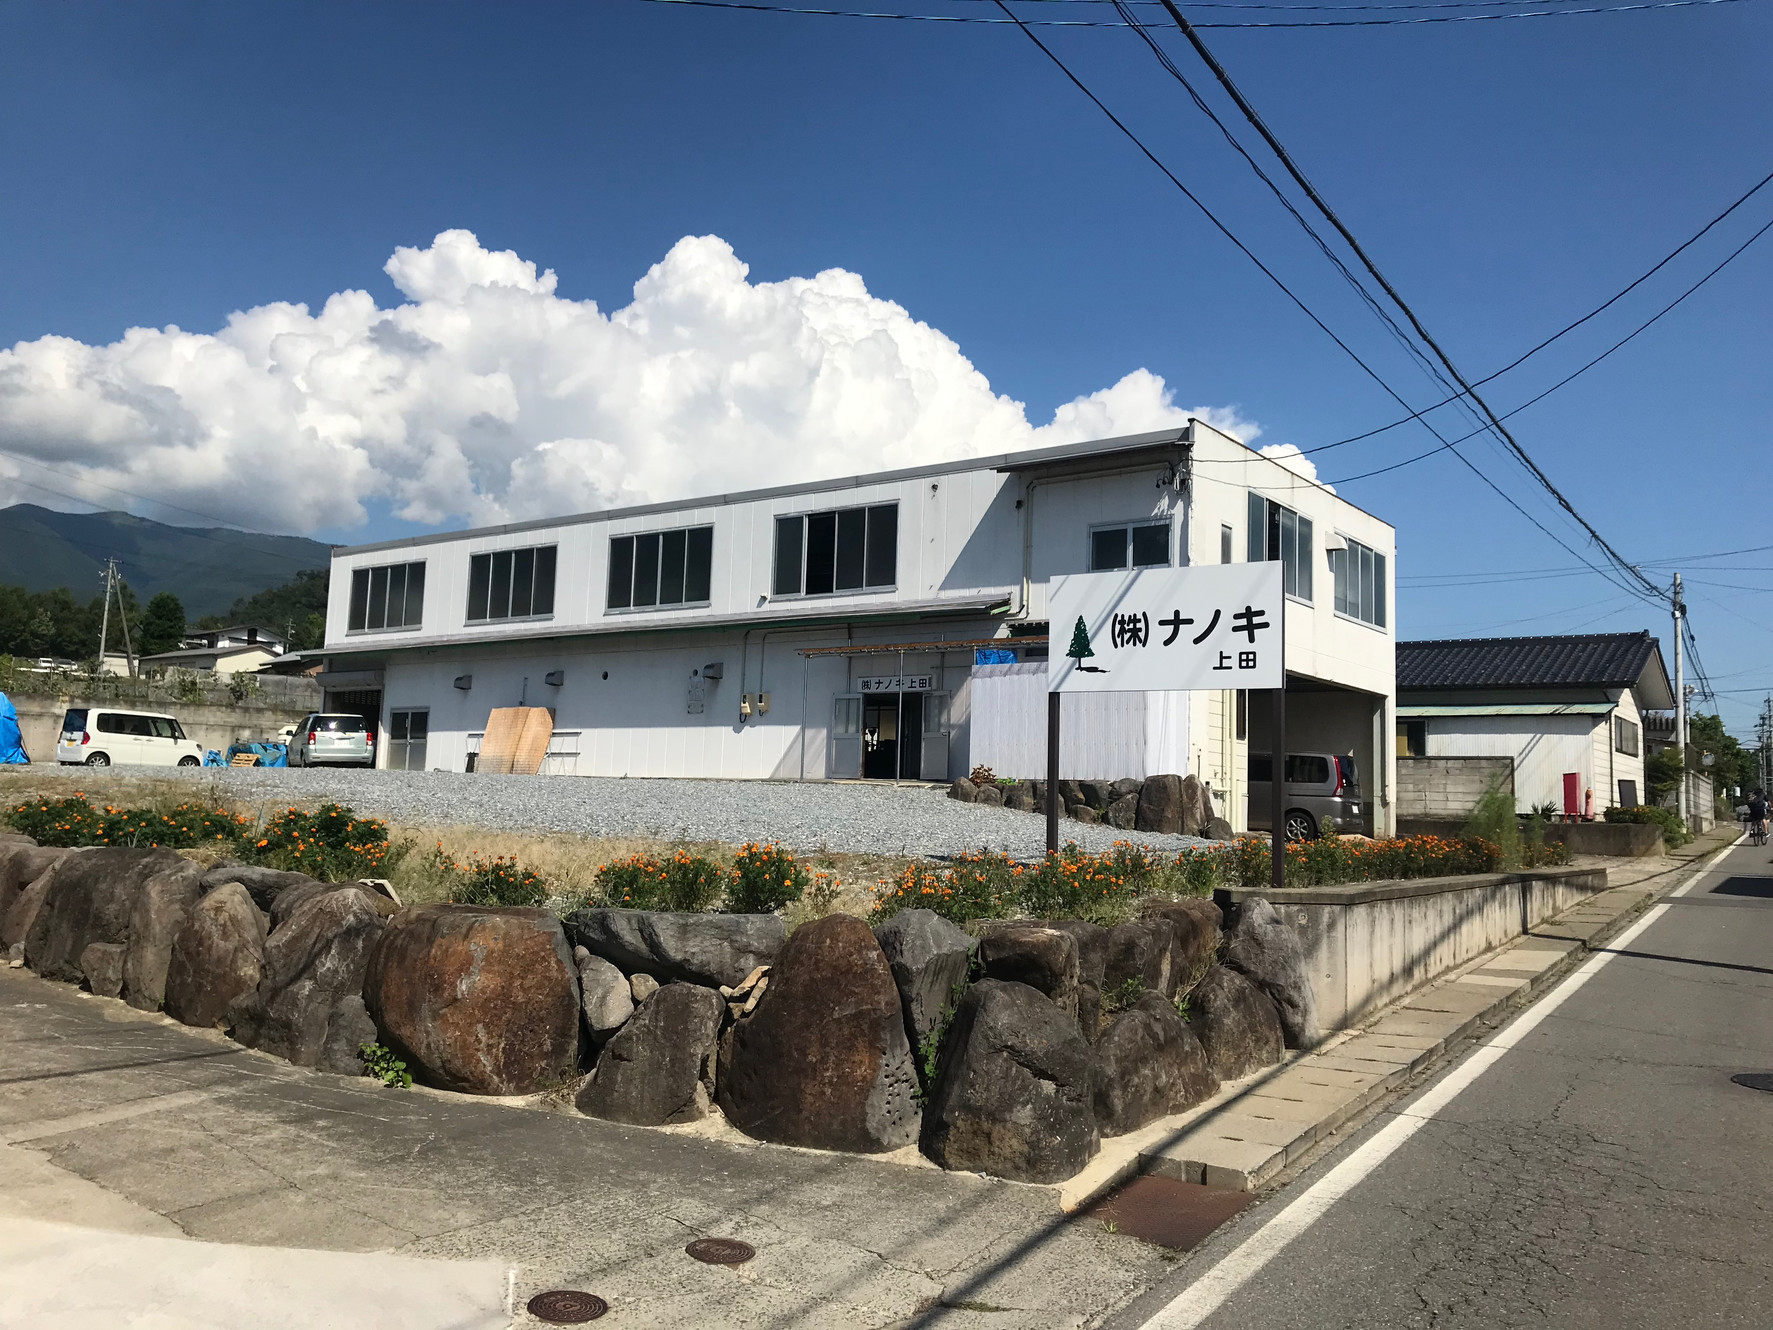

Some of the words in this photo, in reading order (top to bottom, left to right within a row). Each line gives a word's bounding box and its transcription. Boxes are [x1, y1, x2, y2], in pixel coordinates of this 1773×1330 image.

[1111, 605, 1270, 649] (株)ナノキ
[1212, 650, 1257, 670] 上田
